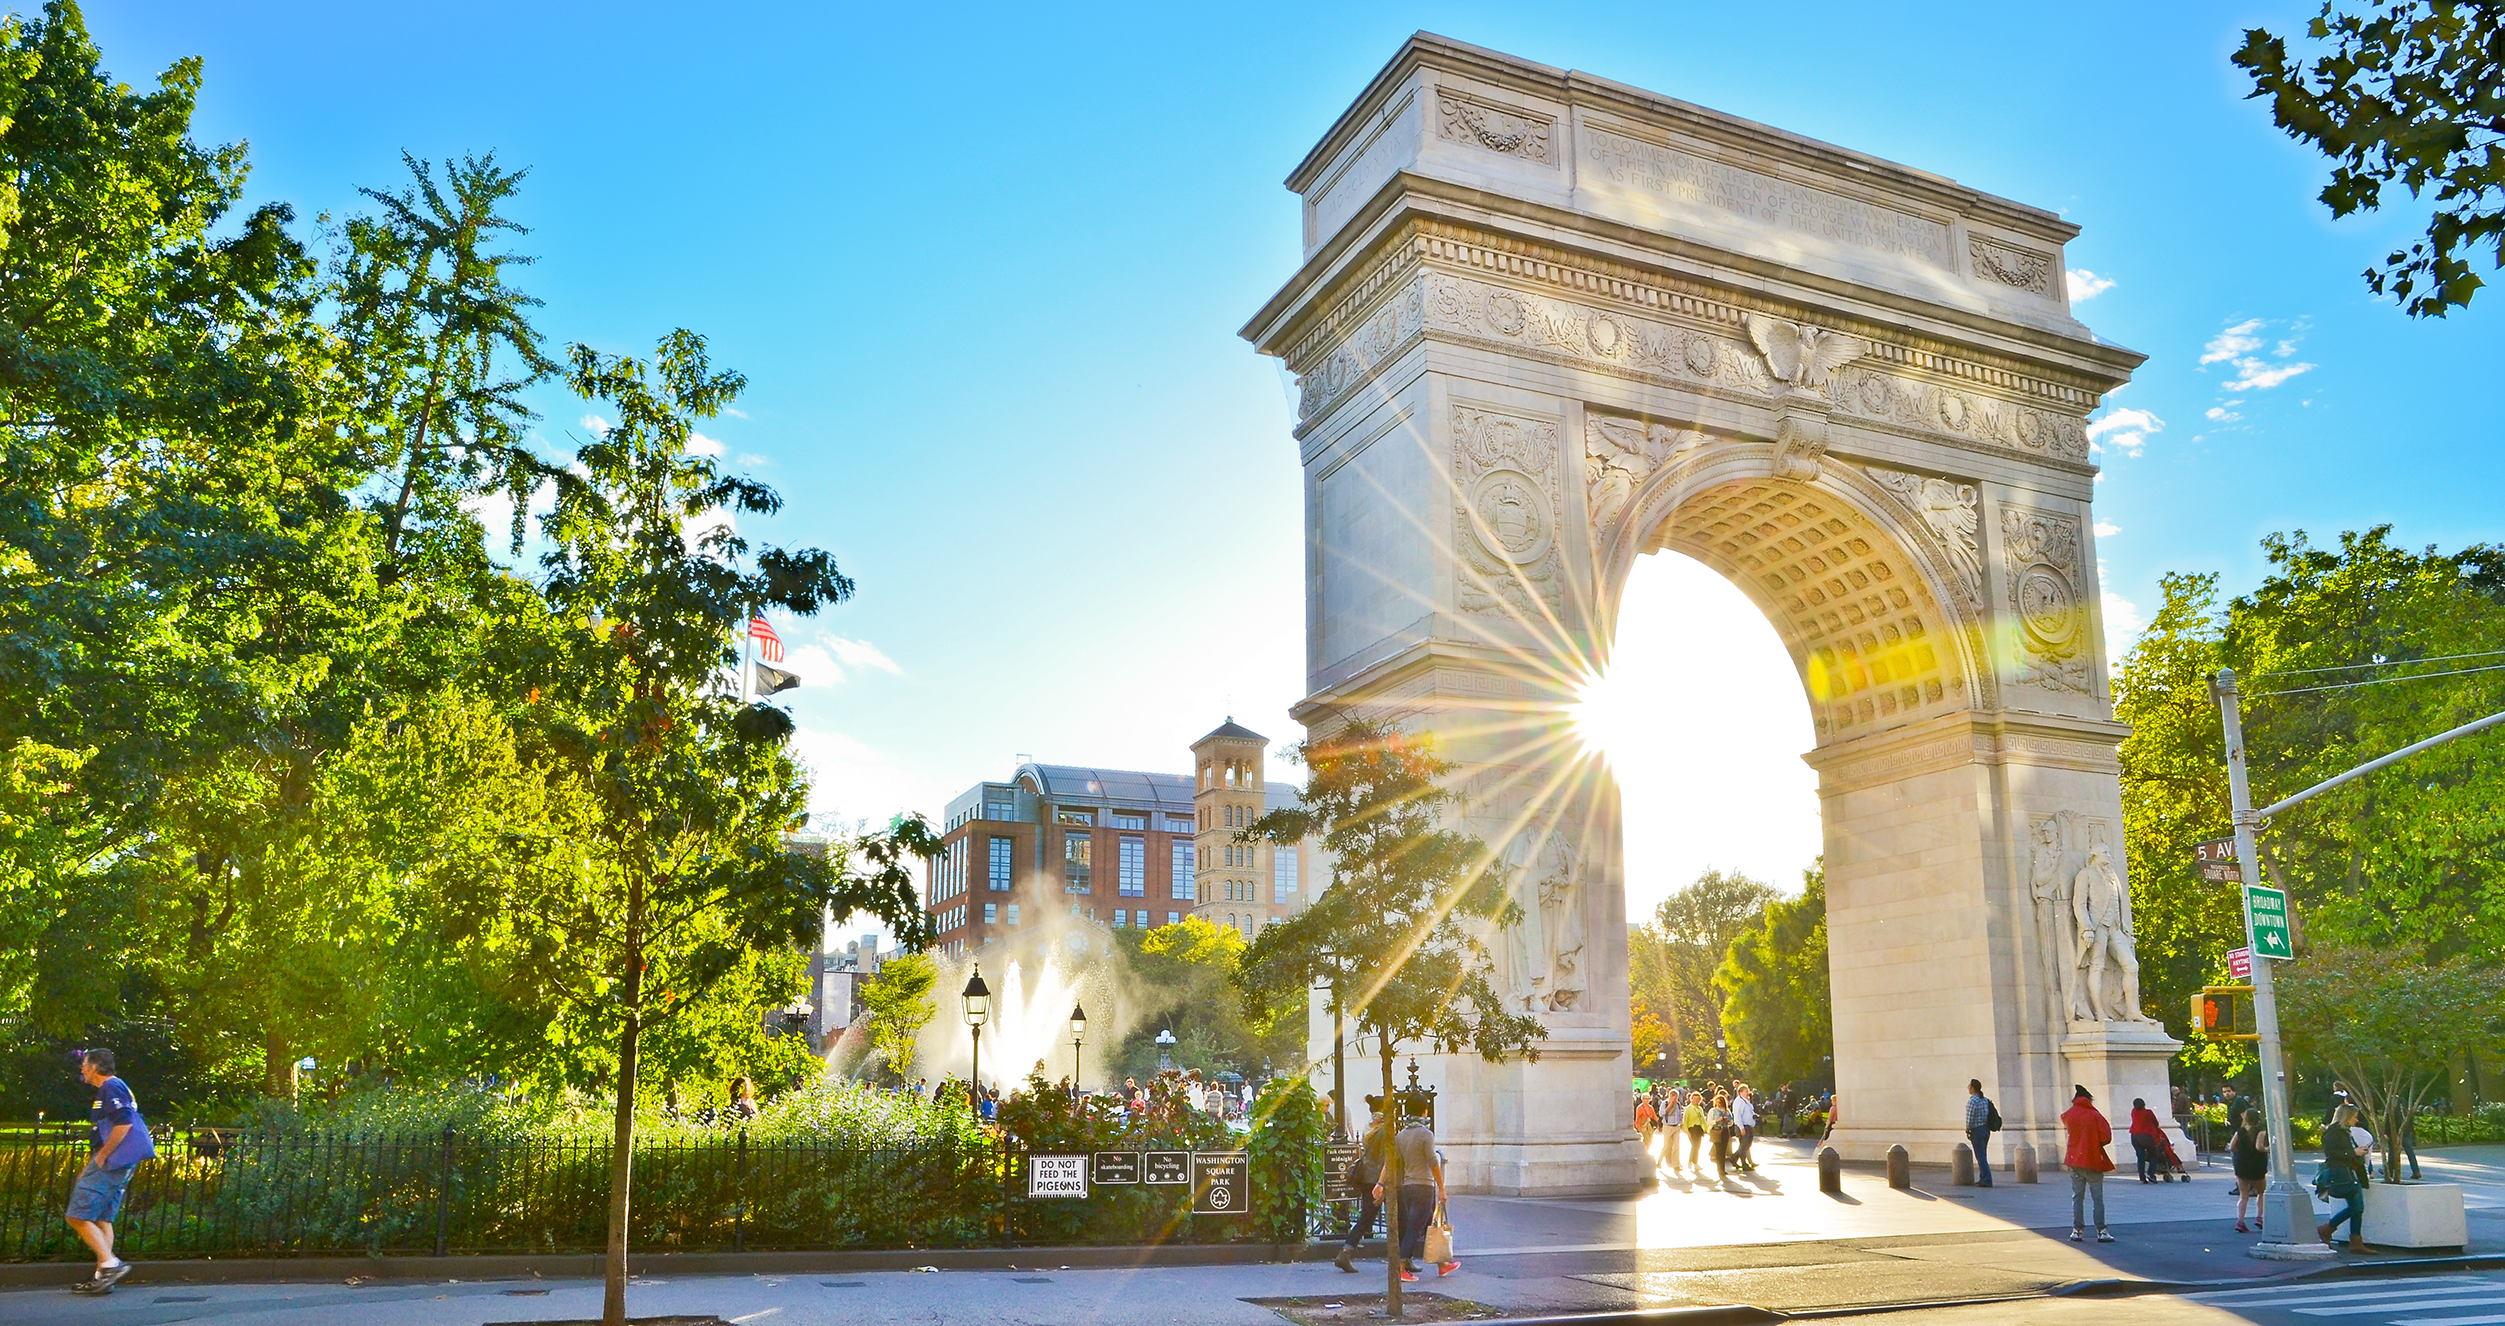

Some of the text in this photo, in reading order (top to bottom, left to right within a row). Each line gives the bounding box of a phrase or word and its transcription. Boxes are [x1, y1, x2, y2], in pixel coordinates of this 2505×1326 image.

[1588, 131, 1941, 238] TO COMMEMORATE THE ONE HUNDREDTH ANNIVERSARY
[1590, 148, 1942, 250] OF THE INAUGURATION OF GEORGE WASHINGTON
[1606, 167, 1625, 182] AS
[1632, 173, 1673, 194] FIRST
[1677, 184, 1754, 216] PRESIDENT
[1761, 208, 1780, 222] OF
[1788, 214, 1817, 233] THE
[1822, 224, 1874, 248] UNITED
[2198, 841, 2232, 860] 5 AV
[2253, 895, 2281, 910] BROADWAY
[2254, 912, 2284, 928] DOWNTOWN
[1058, 1160, 1076, 1168] NOT
[1154, 1162, 1180, 1170] bicycling
[1040, 1170, 1077, 1178] FEED THE
[1206, 1168, 1235, 1176] SQUARE
[1037, 1181, 1081, 1191] PIGEONS
